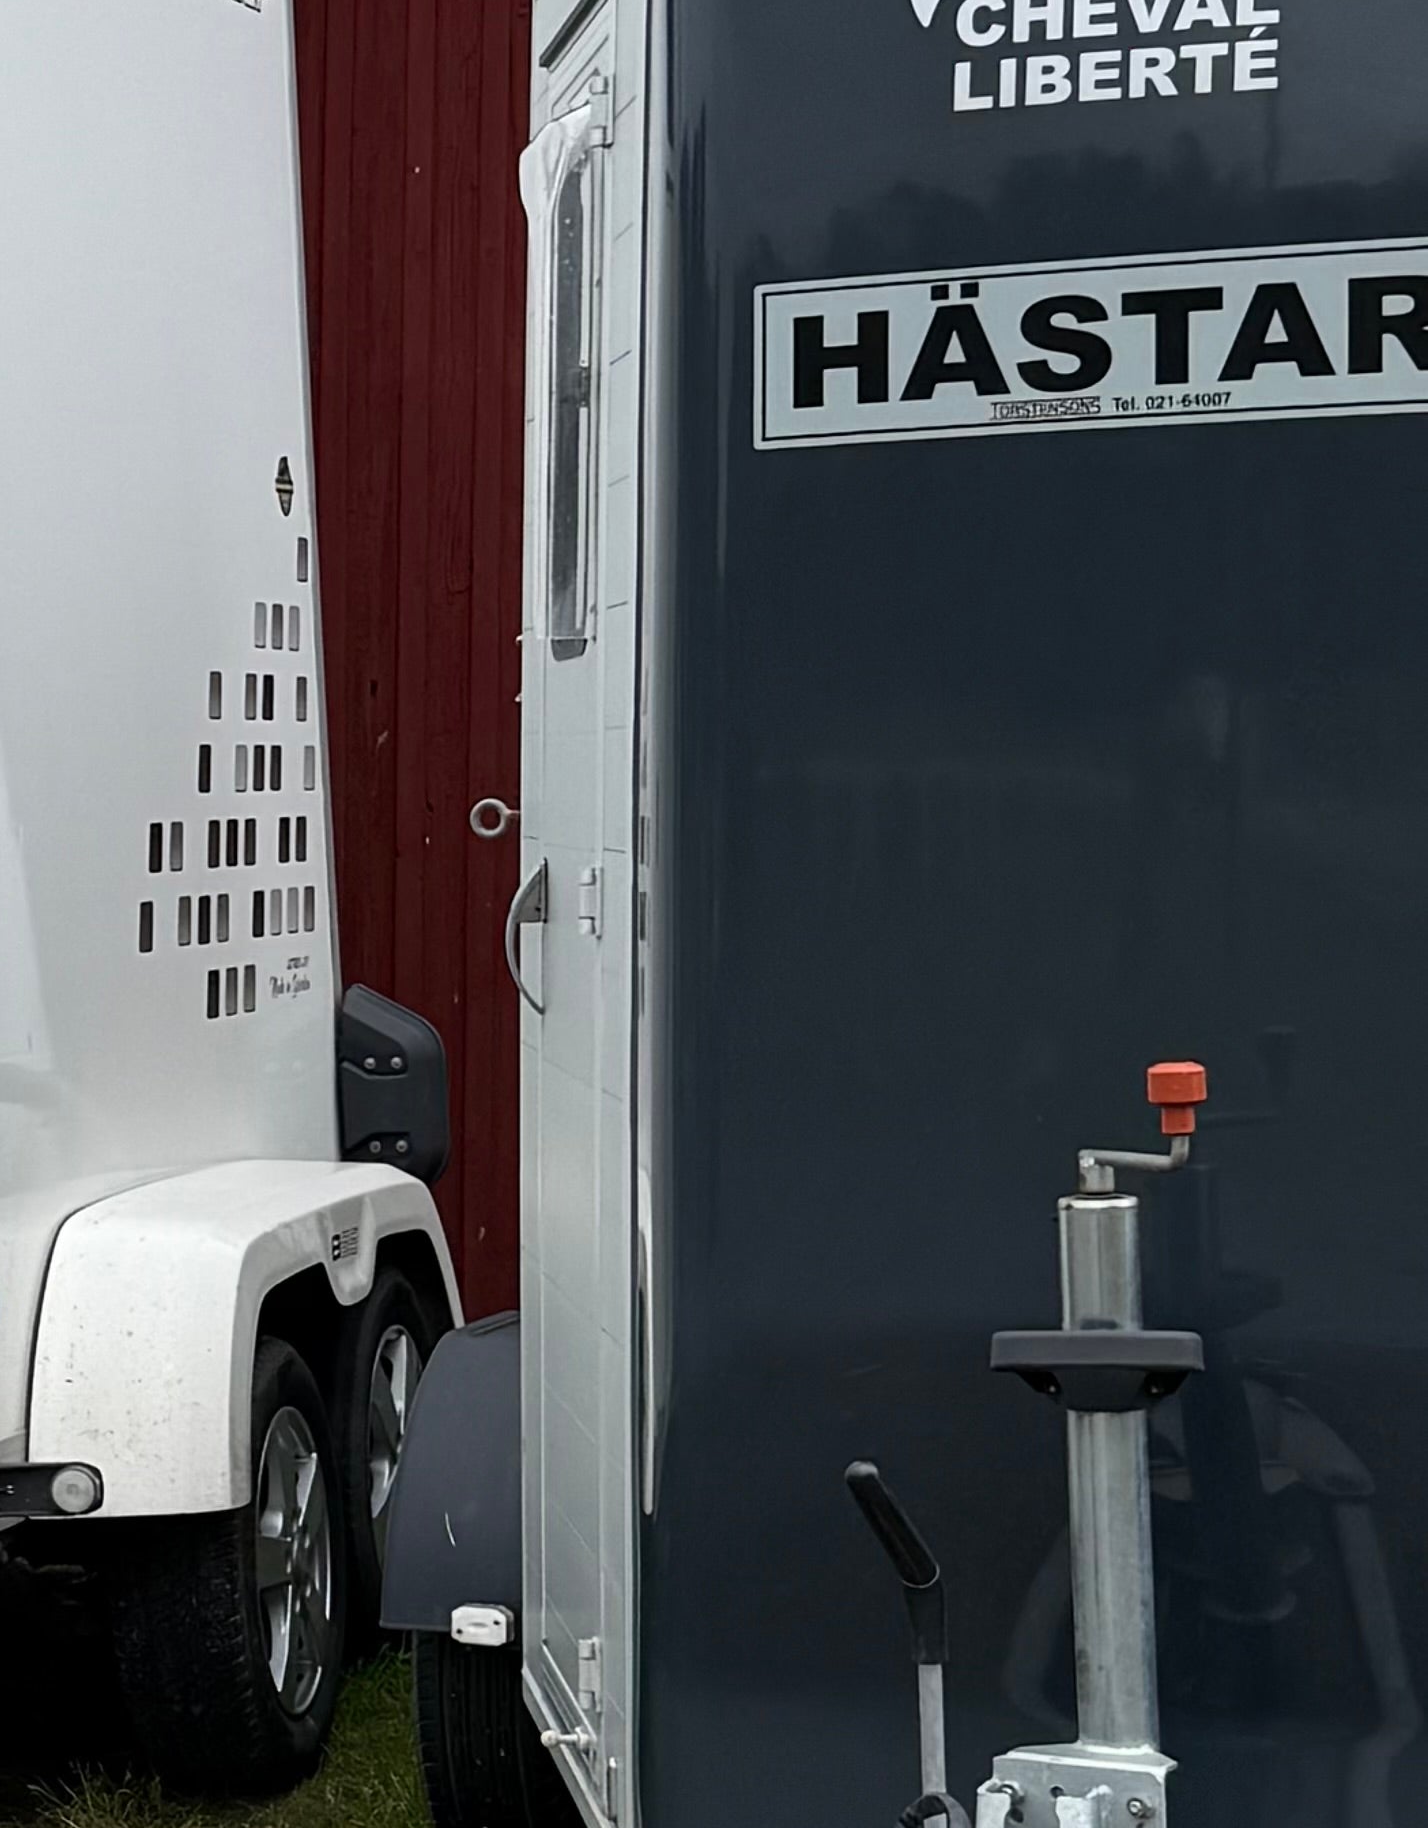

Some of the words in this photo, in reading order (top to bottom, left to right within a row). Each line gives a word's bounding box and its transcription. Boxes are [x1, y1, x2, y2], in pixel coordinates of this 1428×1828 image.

[952, 25, 1280, 112] LIBERTÉ
[792, 275, 1428, 410] HÄSTAR
[1112, 395, 1141, 413] Tel.
